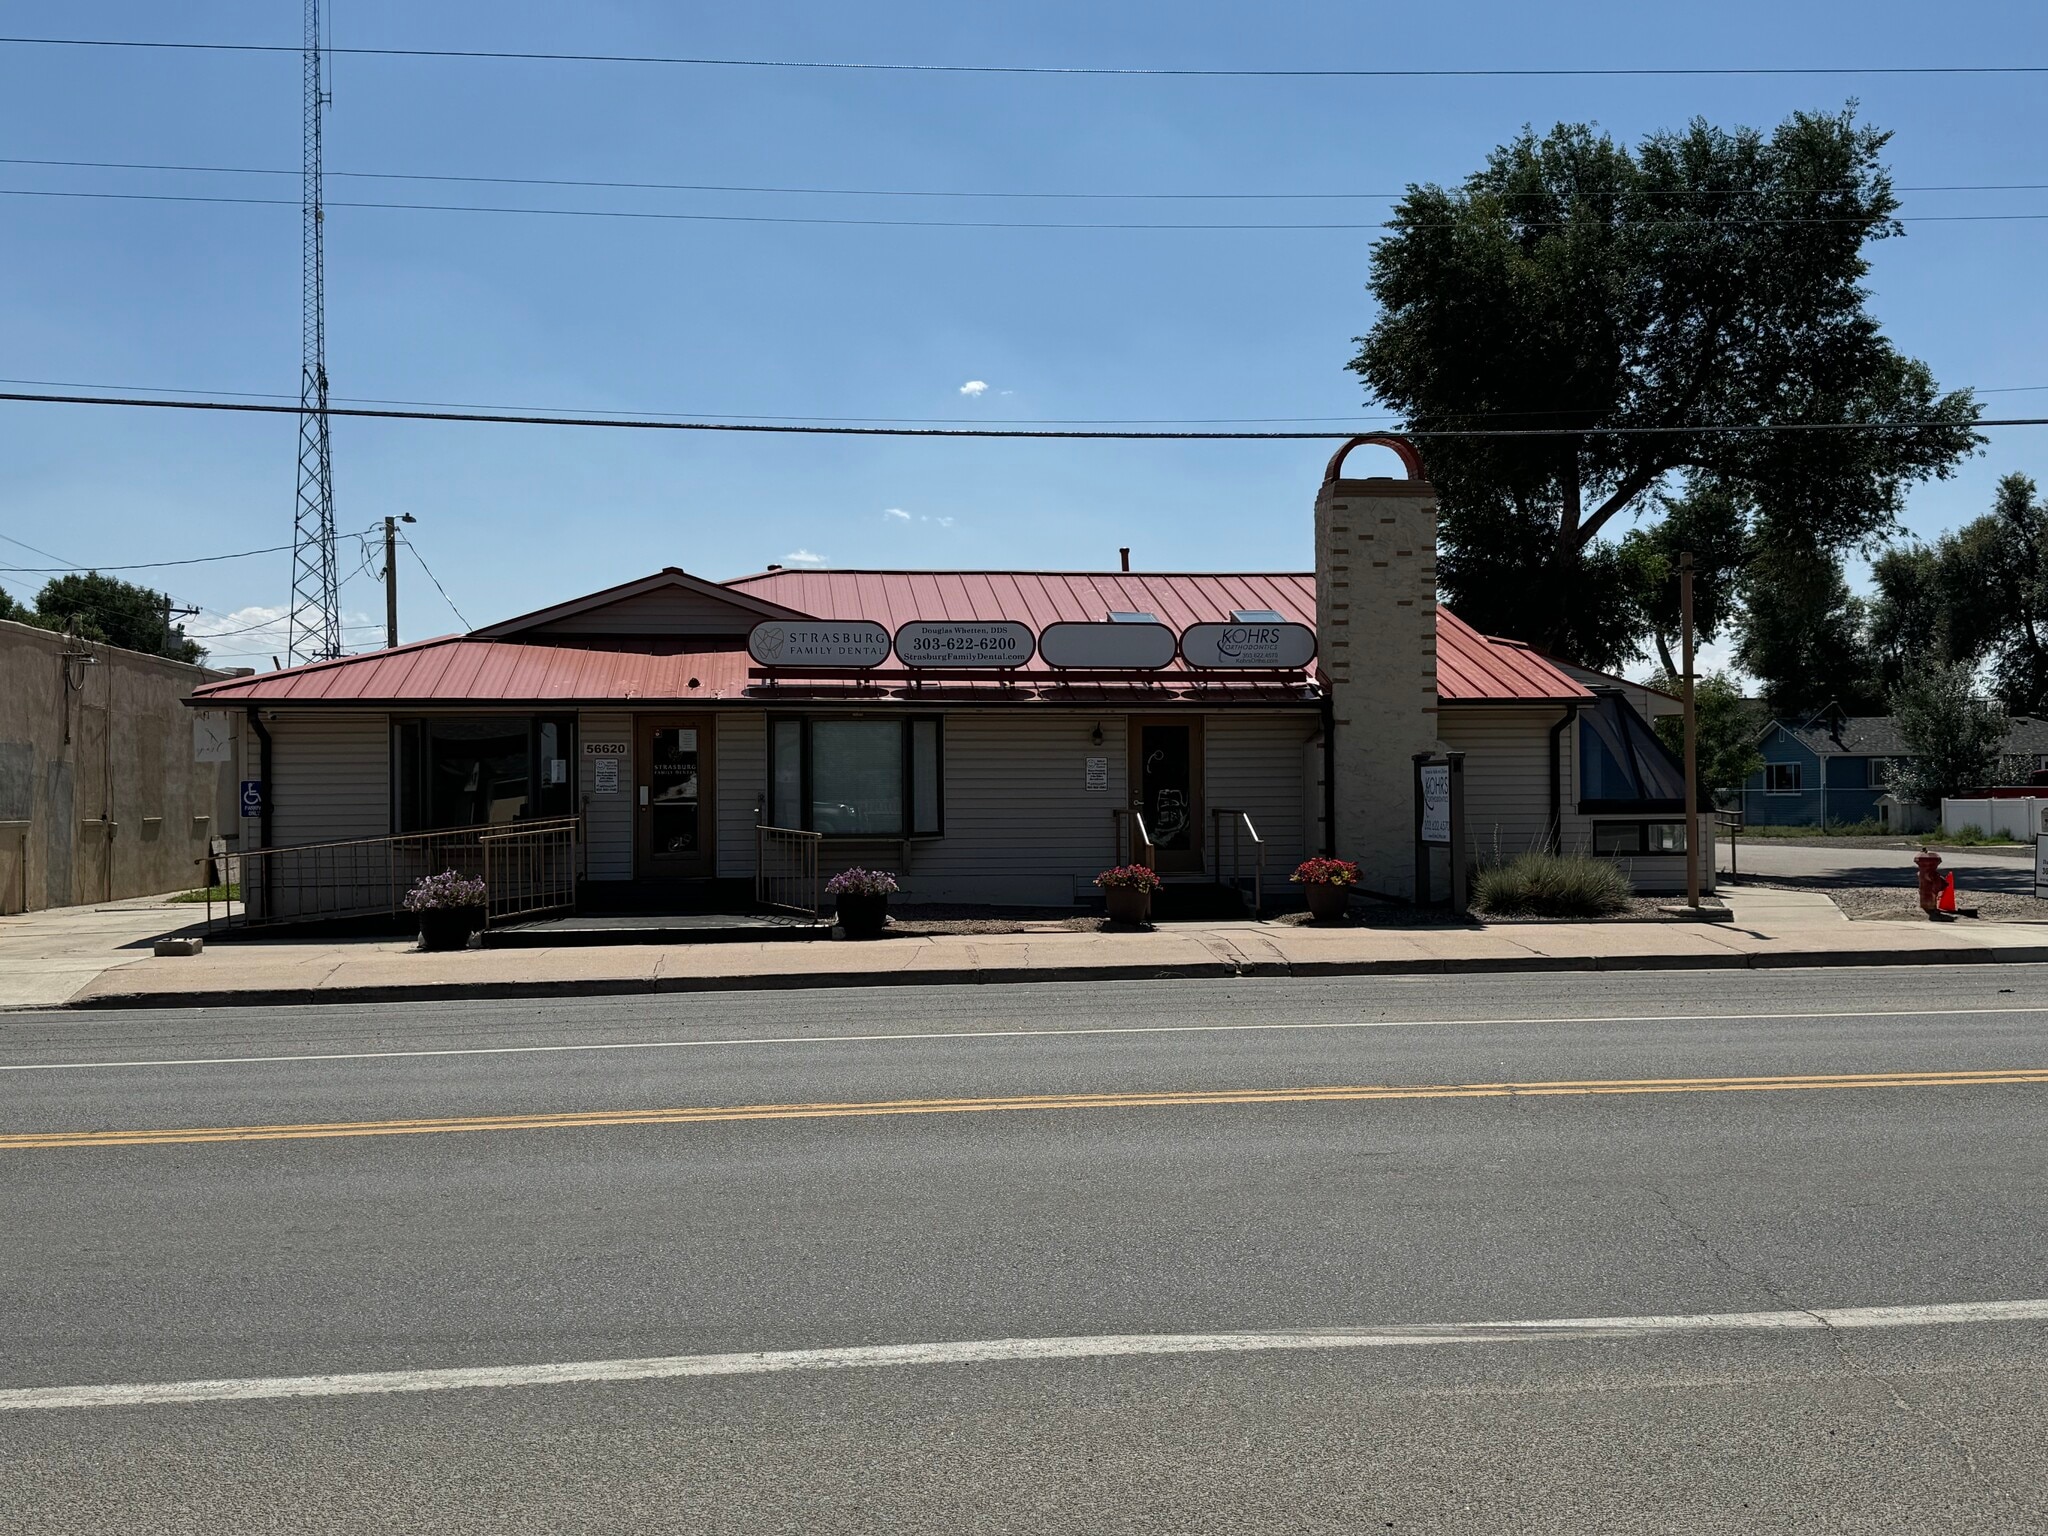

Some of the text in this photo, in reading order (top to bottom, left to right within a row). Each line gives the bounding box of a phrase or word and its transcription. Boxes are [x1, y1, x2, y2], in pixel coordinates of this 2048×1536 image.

[921, 627, 953, 635] Douglas
[1221, 628, 1280, 643] KOHRS
[789, 633, 885, 644] STRASBURG
[913, 637, 1016, 651] 303-622-6200
[790, 647, 885, 655] FAMILY DENTAL
[904, 652, 1026, 662] StrasburgFamilyDental.com
[586, 744, 626, 753] 56620
[1425, 776, 1449, 795] KOHRS
